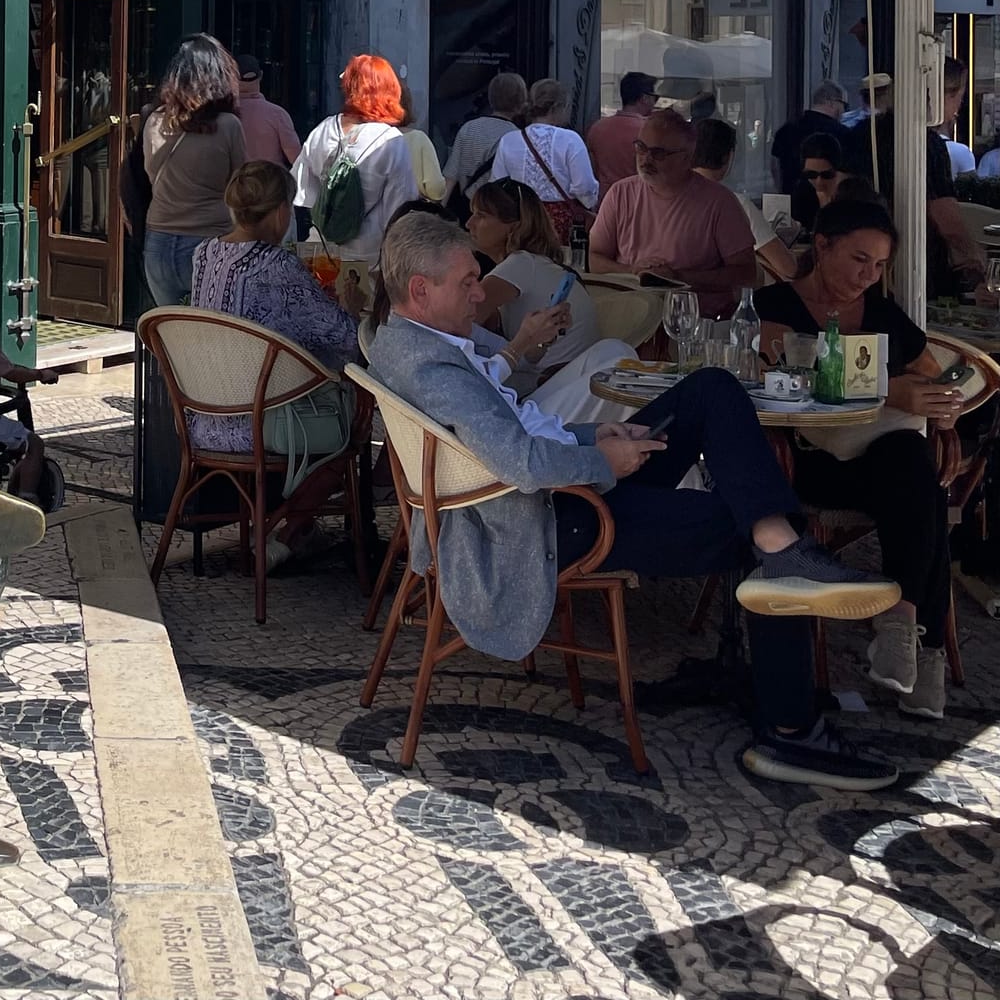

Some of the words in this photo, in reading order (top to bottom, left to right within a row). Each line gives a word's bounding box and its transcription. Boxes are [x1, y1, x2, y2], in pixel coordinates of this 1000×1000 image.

[160, 917, 188, 955] PESSOA
[194, 905, 232, 964] NASCIMENTO
[208, 966, 235, 986] SEU
